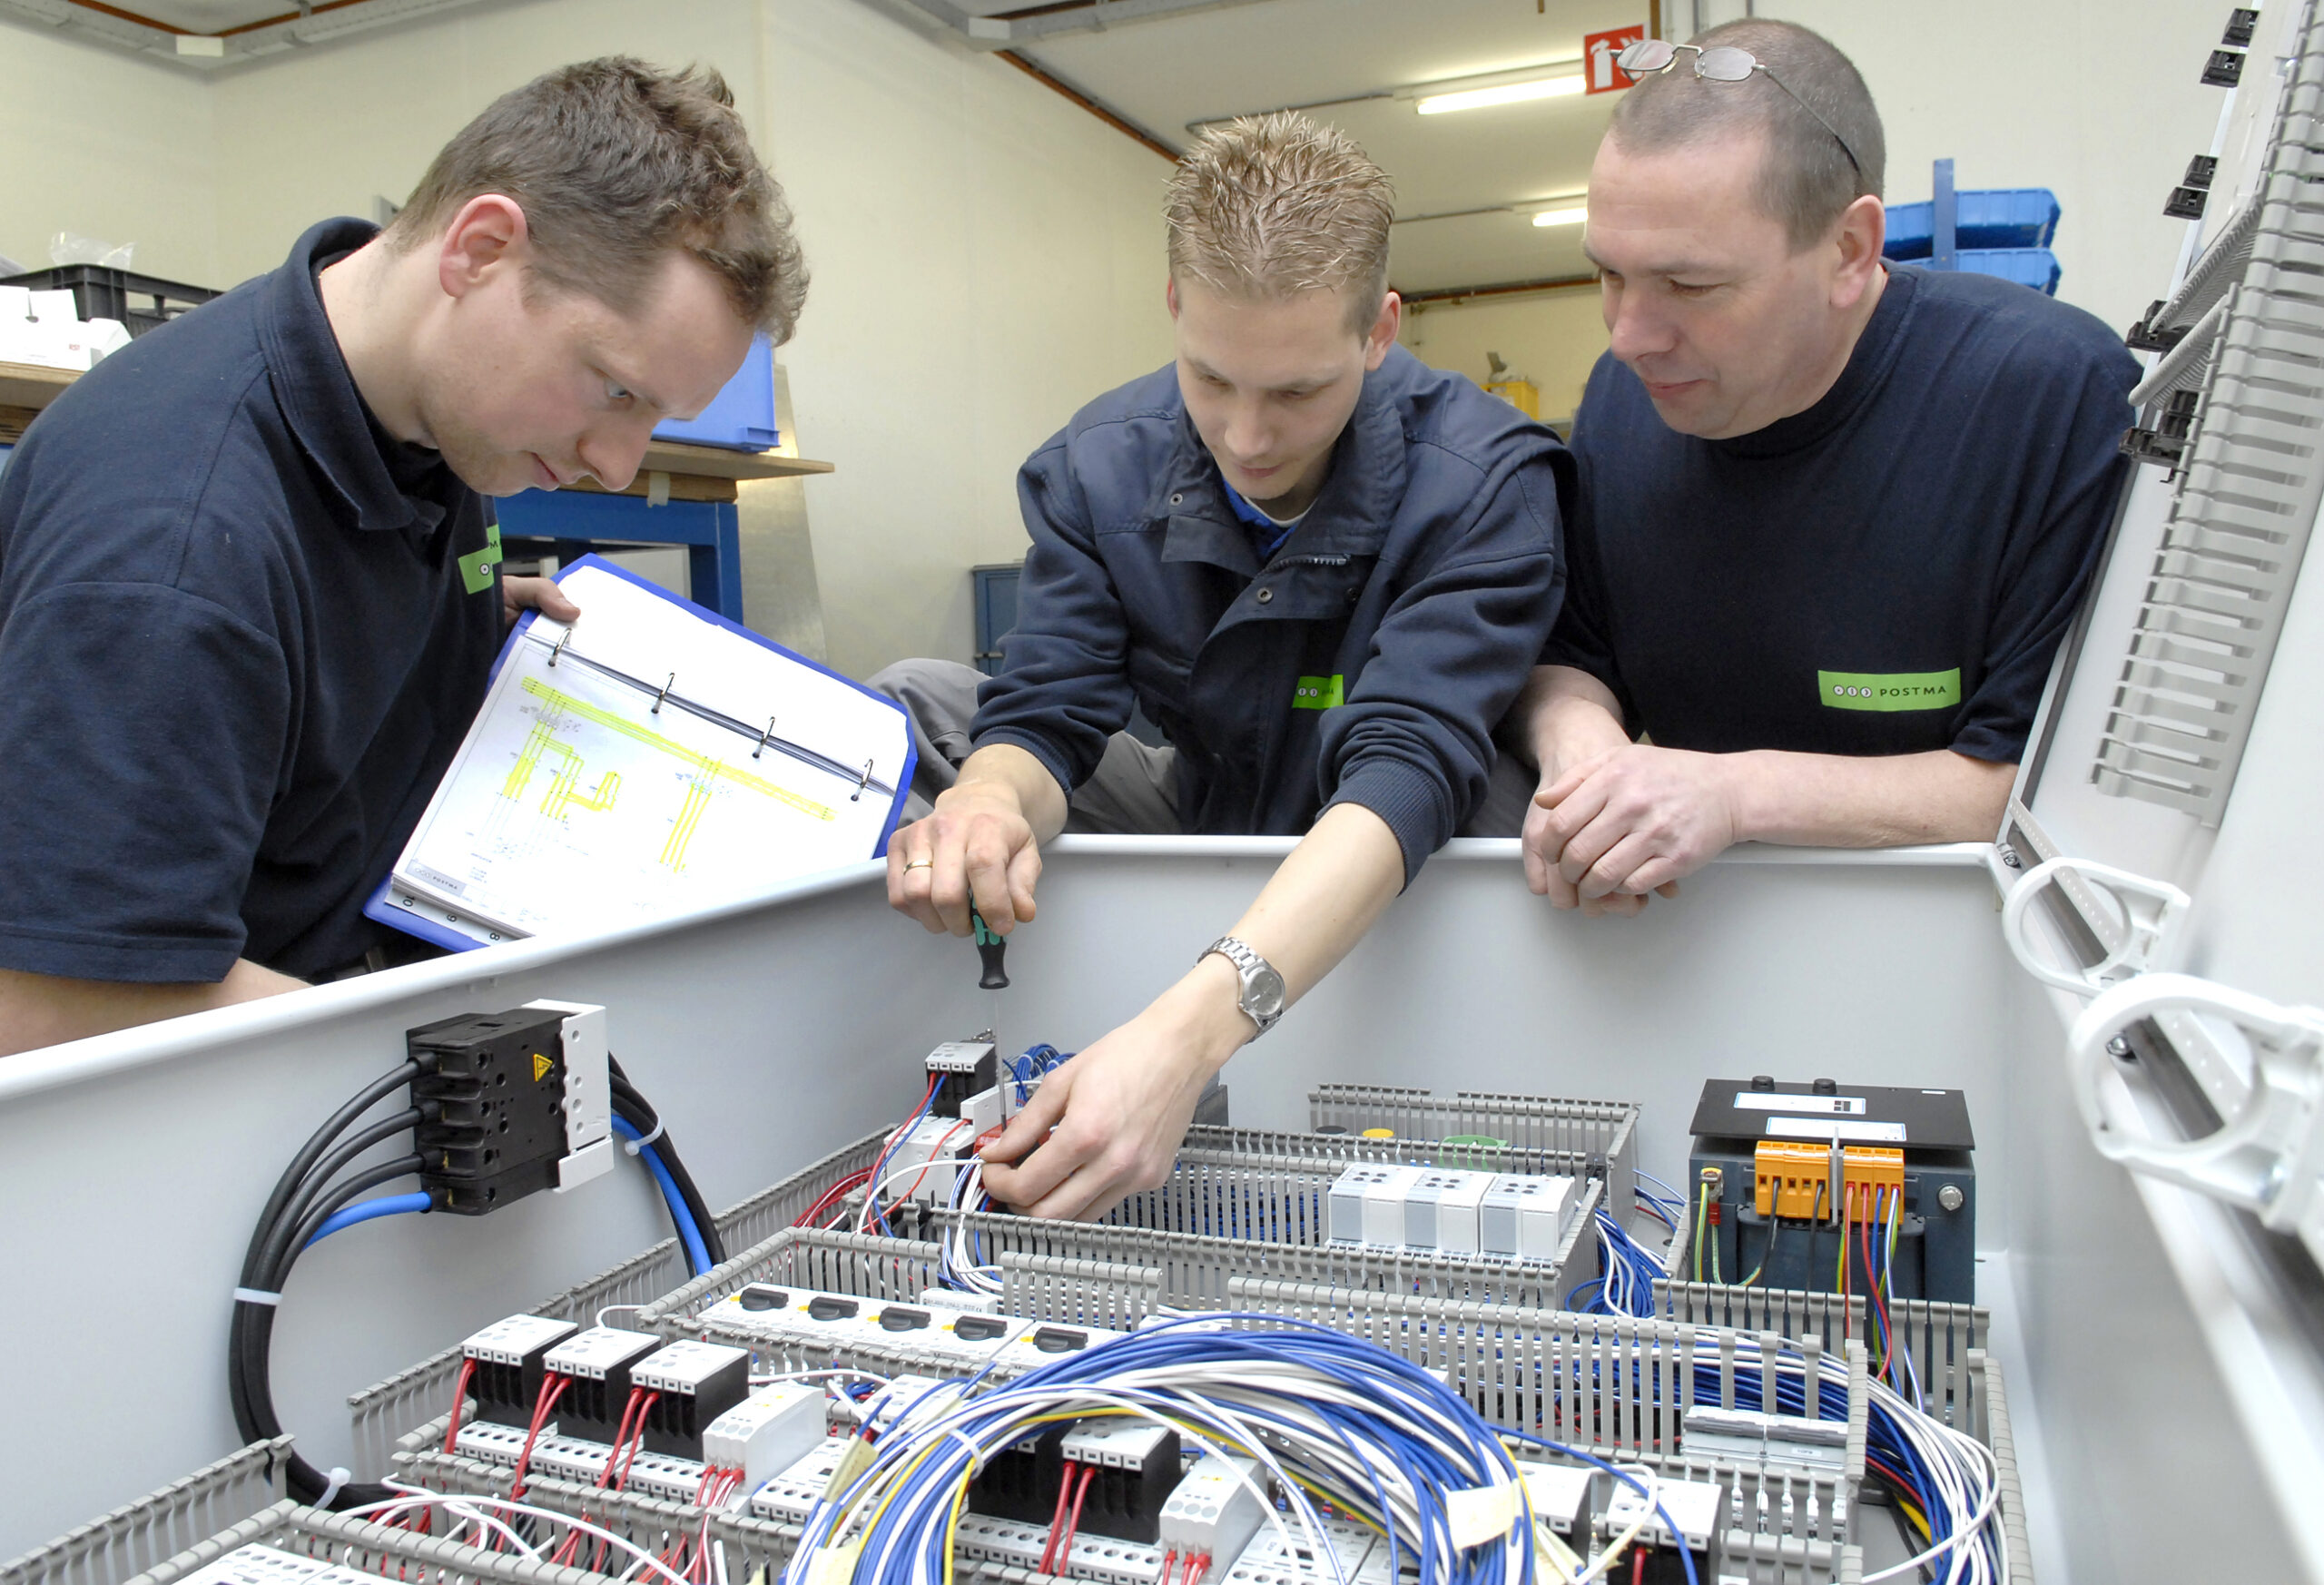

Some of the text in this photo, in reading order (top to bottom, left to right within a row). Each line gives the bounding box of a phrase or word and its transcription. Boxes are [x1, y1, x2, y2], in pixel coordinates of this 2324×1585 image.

[1879, 685, 1947, 697] POSTMA
[431, 875, 458, 891] POSTMA
[402, 895, 416, 907] 10
[446, 913, 458, 922] 9
[489, 932, 500, 941] 8
